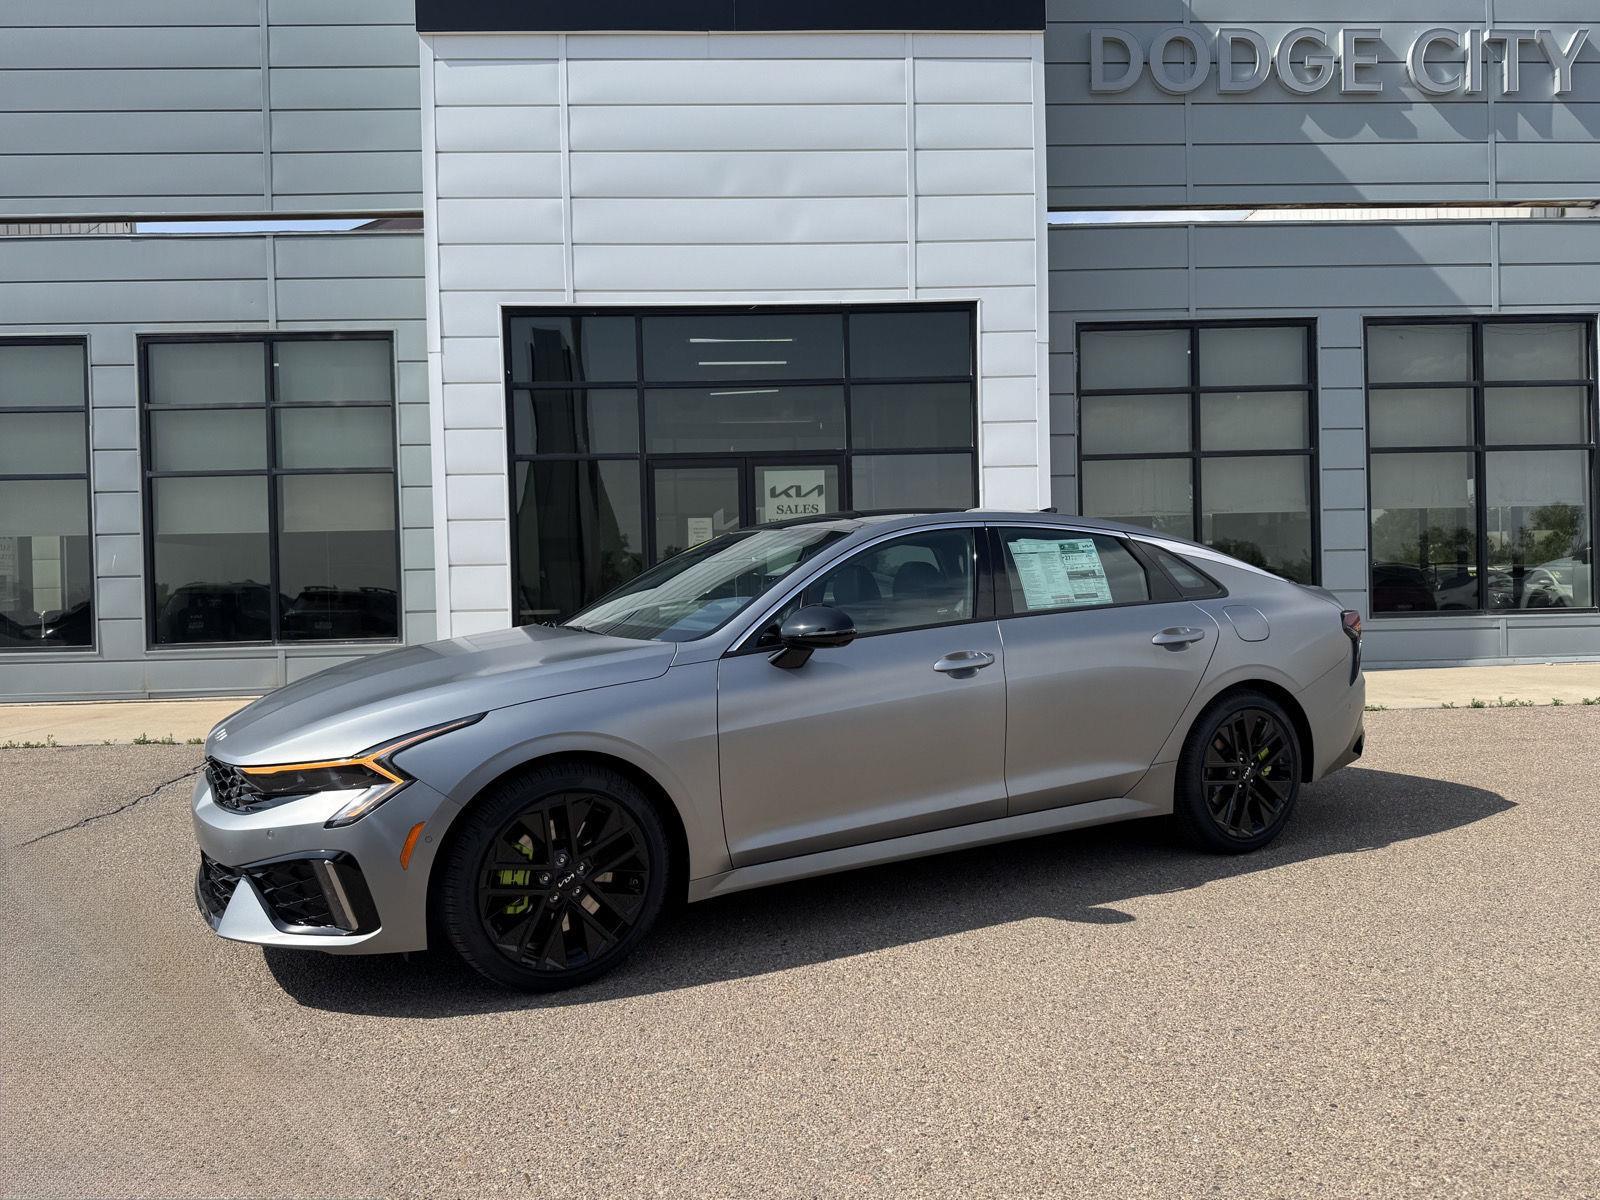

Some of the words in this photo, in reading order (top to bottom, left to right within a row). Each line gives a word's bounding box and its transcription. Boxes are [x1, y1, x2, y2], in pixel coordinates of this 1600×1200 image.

[1089, 27, 1383, 95] DODGE
[1406, 27, 1590, 95] CITY
[769, 484, 824, 499] KIA
[776, 503, 819, 515] SALES
